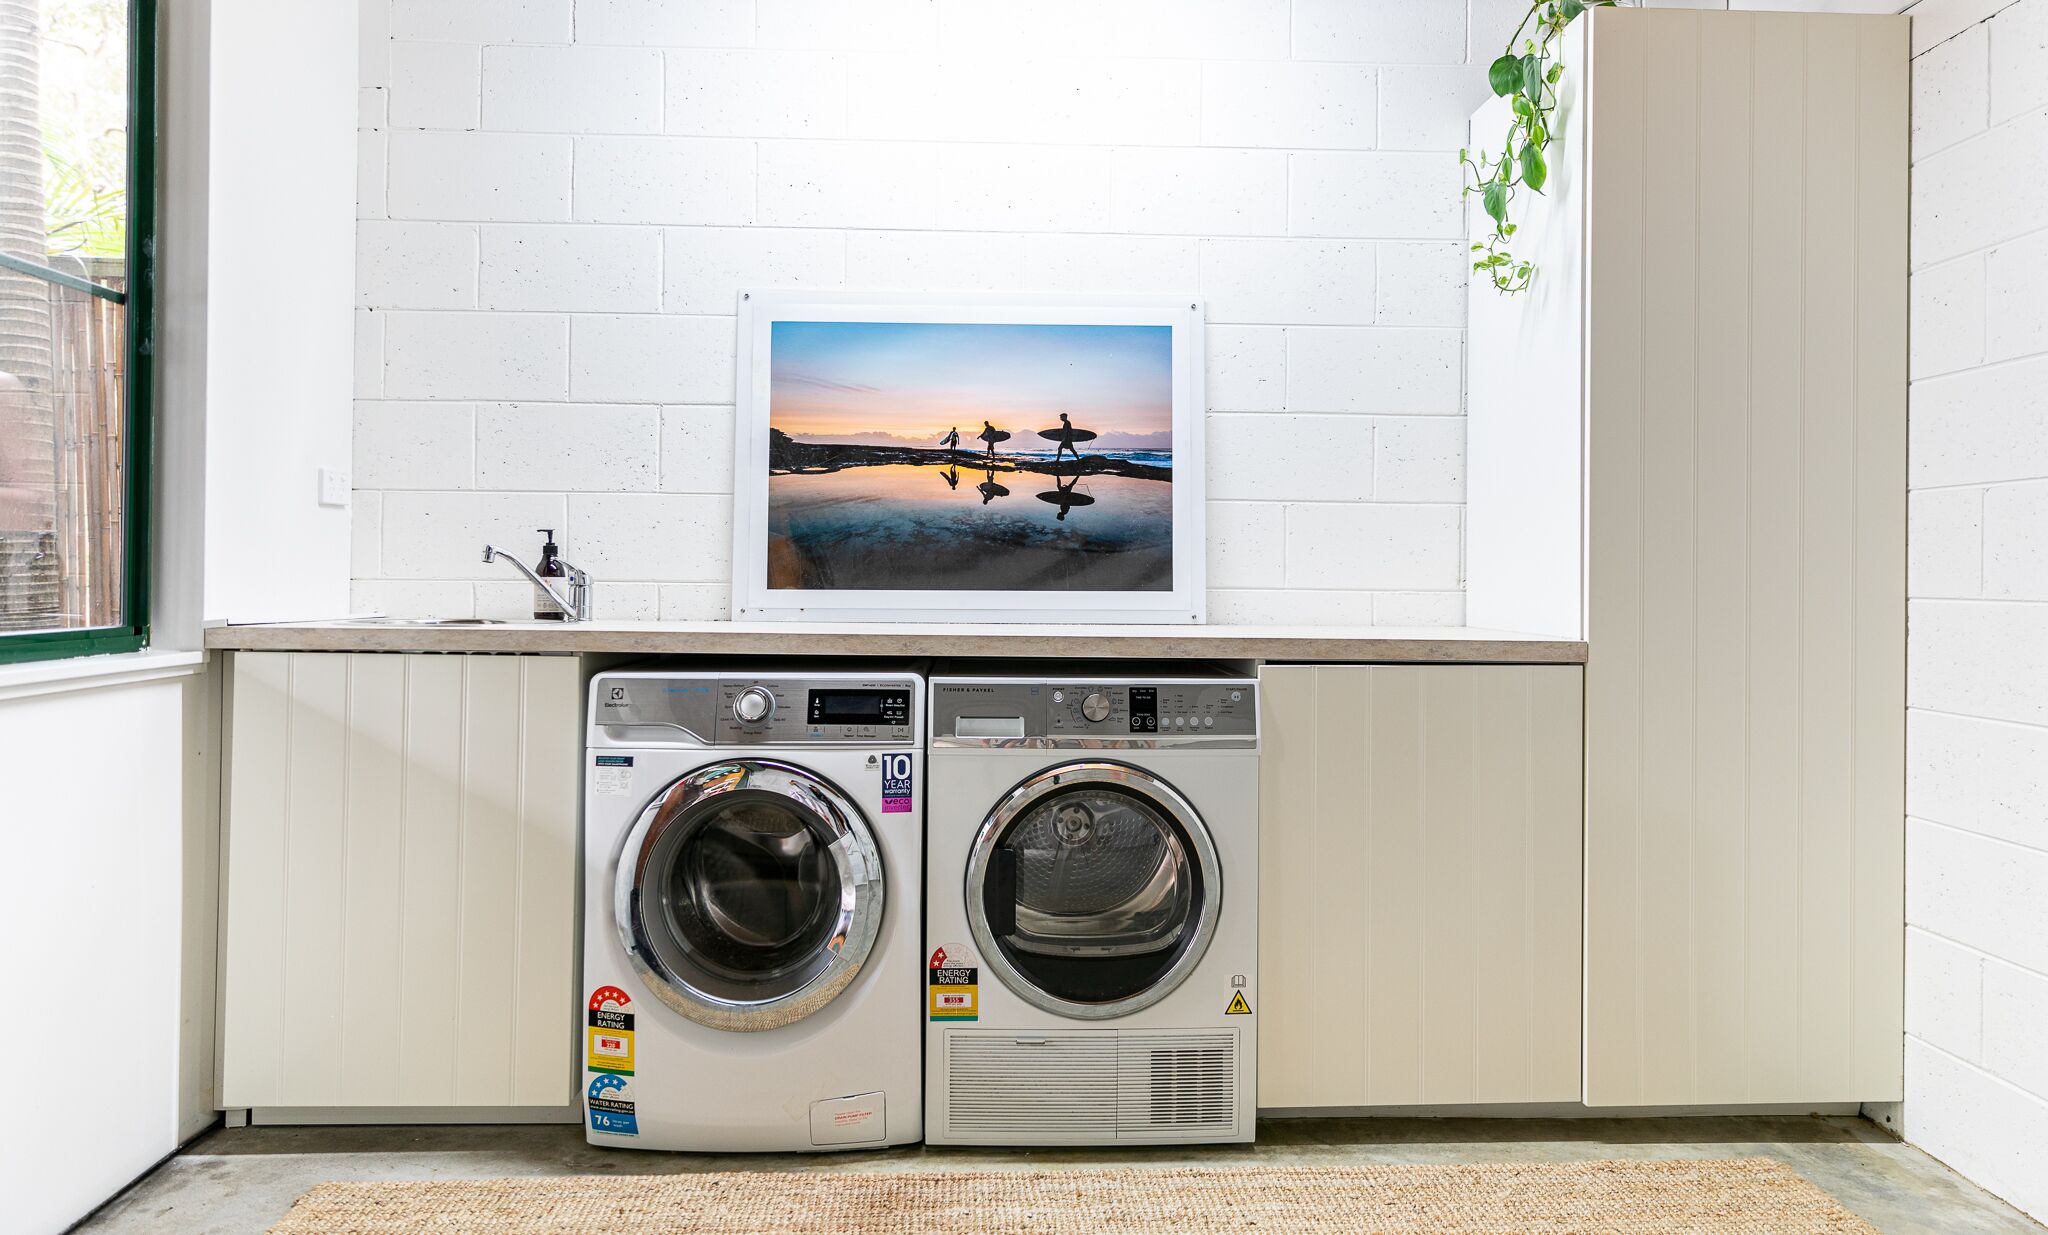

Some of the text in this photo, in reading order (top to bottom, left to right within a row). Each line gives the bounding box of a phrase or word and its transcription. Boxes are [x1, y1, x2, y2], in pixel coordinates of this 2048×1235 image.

[884, 755, 910, 780] 10
[884, 780, 910, 789] YEAR
[937, 969, 971, 977] ENERGY
[597, 1011, 626, 1021] ENERGY
[597, 1020, 625, 1030] RATING
[590, 1099, 634, 1110] WATER RATING
[595, 1115, 610, 1126] 76
